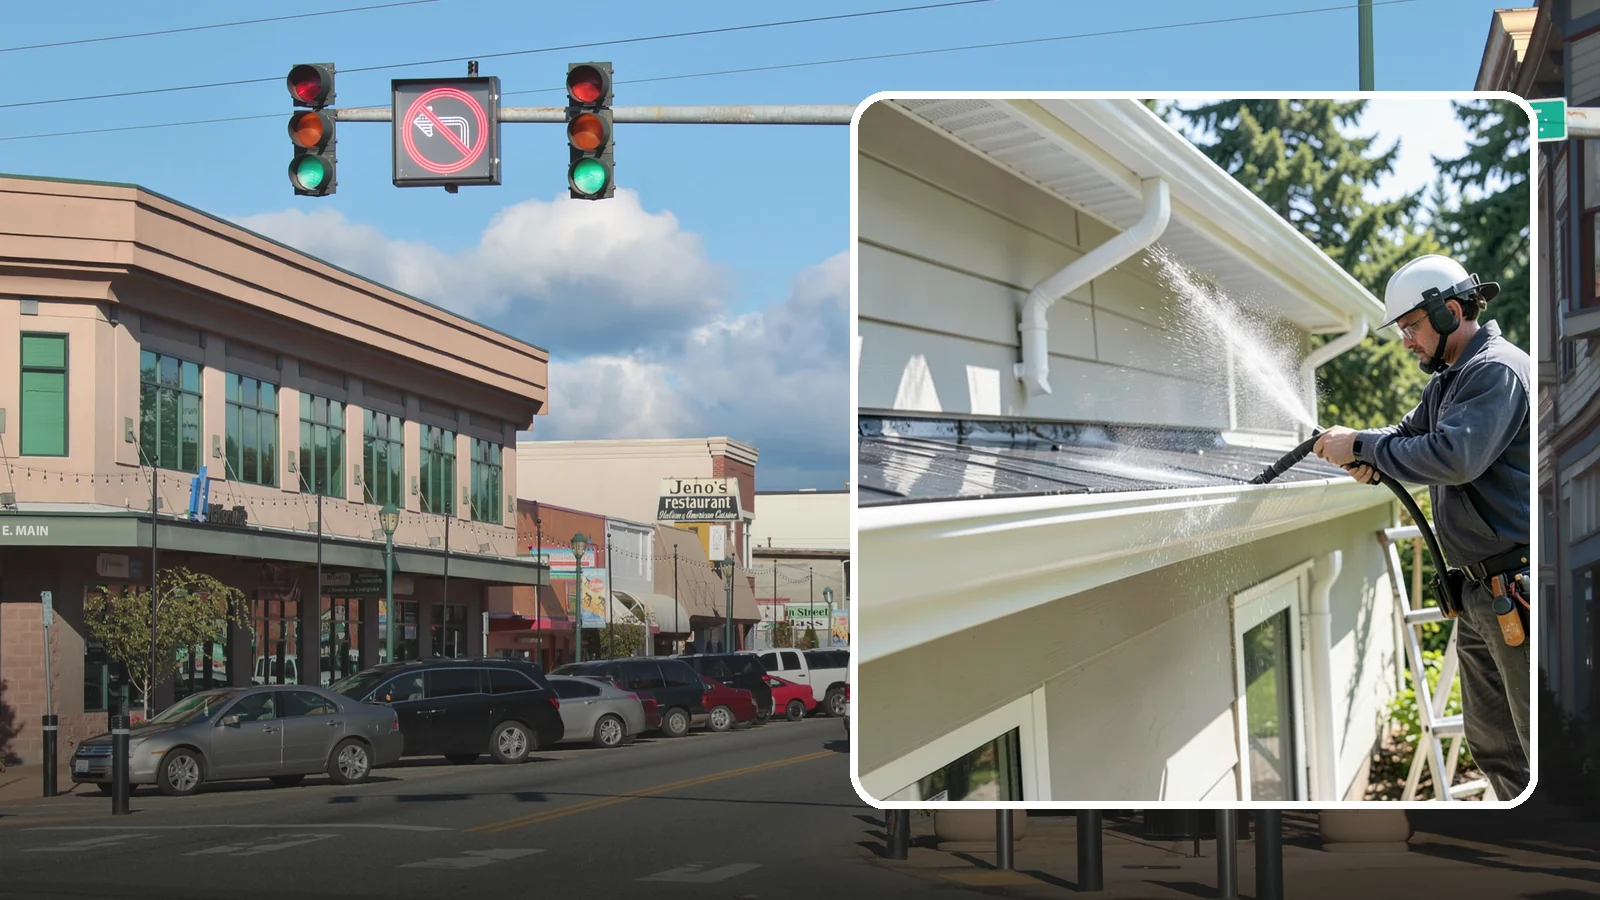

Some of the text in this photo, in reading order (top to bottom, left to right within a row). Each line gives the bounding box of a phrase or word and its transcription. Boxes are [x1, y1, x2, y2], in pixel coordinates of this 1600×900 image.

[670, 480, 727, 494] Jeno's
[665, 497, 731, 509] restaurant
[659, 510, 681, 519] Italian
[686, 510, 714, 519] American
[715, 510, 737, 519] Cuisine
[2, 525, 49, 536] E. MAIN
[797, 607, 828, 617] Street
[791, 619, 823, 627] lass
